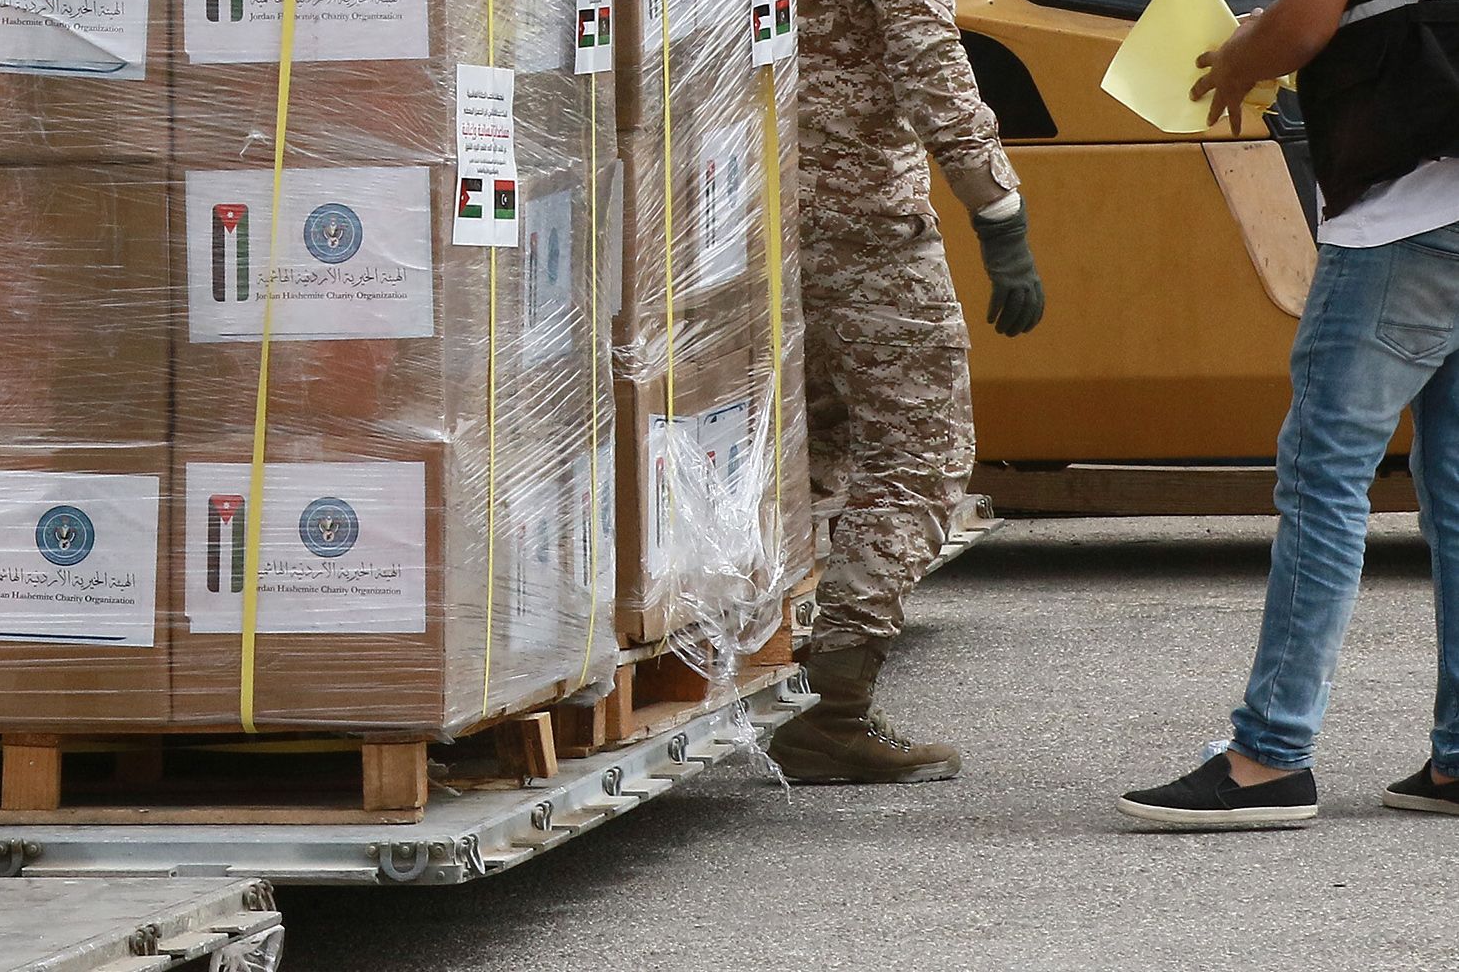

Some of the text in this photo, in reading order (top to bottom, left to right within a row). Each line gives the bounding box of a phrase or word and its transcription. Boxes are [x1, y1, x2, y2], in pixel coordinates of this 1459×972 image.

[249, 12, 276, 21] Jordan
[321, 12, 350, 22] Charity
[351, 12, 402, 21] Organization
[1, 16, 43, 27] Hashemite
[44, 18, 71, 30] Charity
[73, 21, 125, 33] Organization
[326, 291, 354, 301] Charity
[356, 291, 408, 300] Organization
[73, 571, 108, 590] الخيرية
[109, 573, 135, 591] الهيئة
[277, 585, 319, 593] Hashemite
[320, 585, 349, 596] Charity
[350, 586, 401, 596] Organization
[12, 591, 53, 601] Hashemite
[55, 593, 83, 603] Charity
[85, 594, 135, 605] Organization
